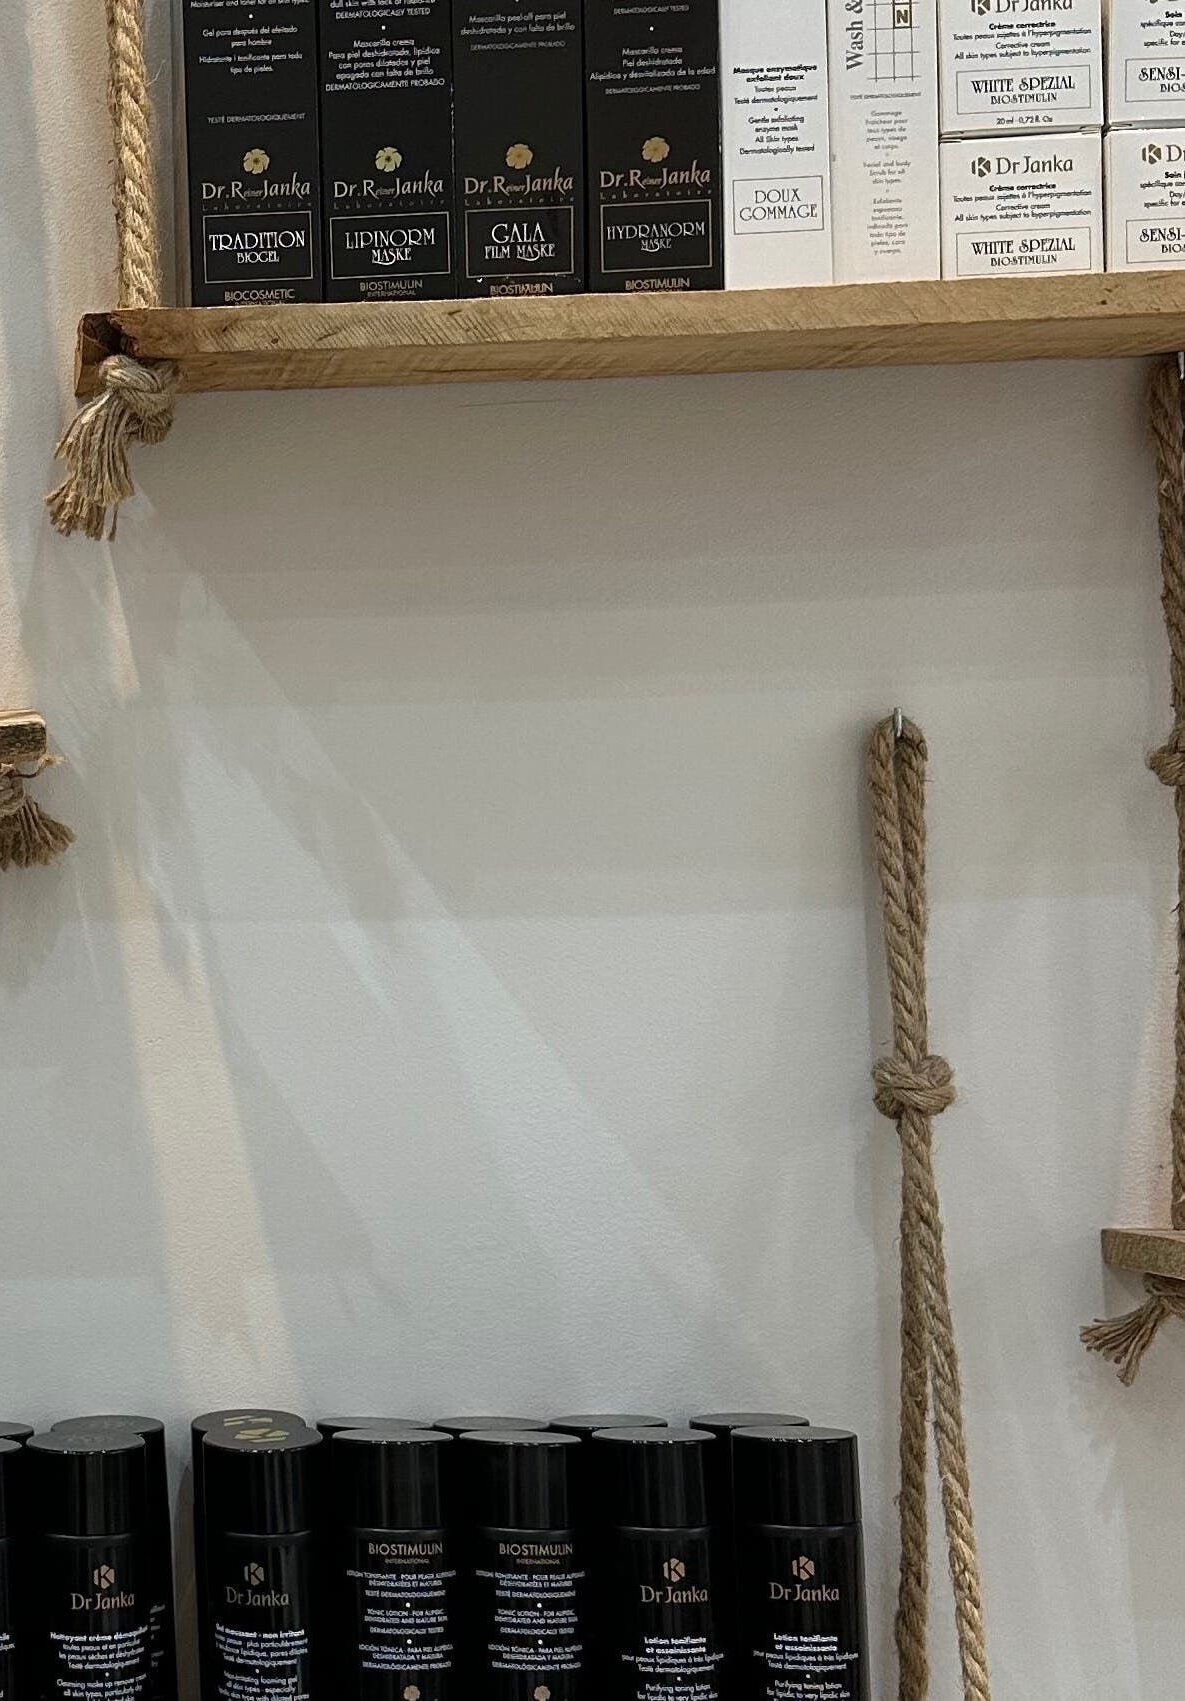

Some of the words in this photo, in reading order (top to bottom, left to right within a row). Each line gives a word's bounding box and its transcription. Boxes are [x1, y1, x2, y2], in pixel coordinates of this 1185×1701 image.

[846, 20, 864, 70] Wash
[971, 78, 1014, 94] WHITE
[1019, 76, 1075, 92] SPEZIAL
[991, 92, 1057, 105] BIOSTIMULIN
[755, 188, 801, 204] DOUX
[740, 204, 818, 222] GOMMAGE
[345, 228, 435, 249] LIPINORM
[491, 222, 545, 243] GALA
[607, 222, 705, 240] HYDRANORM
[209, 231, 305, 251] TRADITION
[641, 239, 671, 252] MASKE
[971, 240, 1014, 256] WHITE
[1019, 238, 1075, 253] SPEZIAL
[237, 251, 279, 263] BIOGEL
[372, 248, 411, 266] MASKE
[485, 245, 510, 259] FILM
[517, 244, 555, 261] MASKE
[991, 254, 1057, 267] BIOSTIMULIN
[360, 280, 423, 291] BIOSTIMULIN
[625, 278, 690, 290] BIOSTIMULIN
[225, 289, 295, 301] BIOCOSMETIC
[368, 1542, 443, 1556] BIOSTIMULIN
[499, 1542, 573, 1556] BIOSTIMULIN
